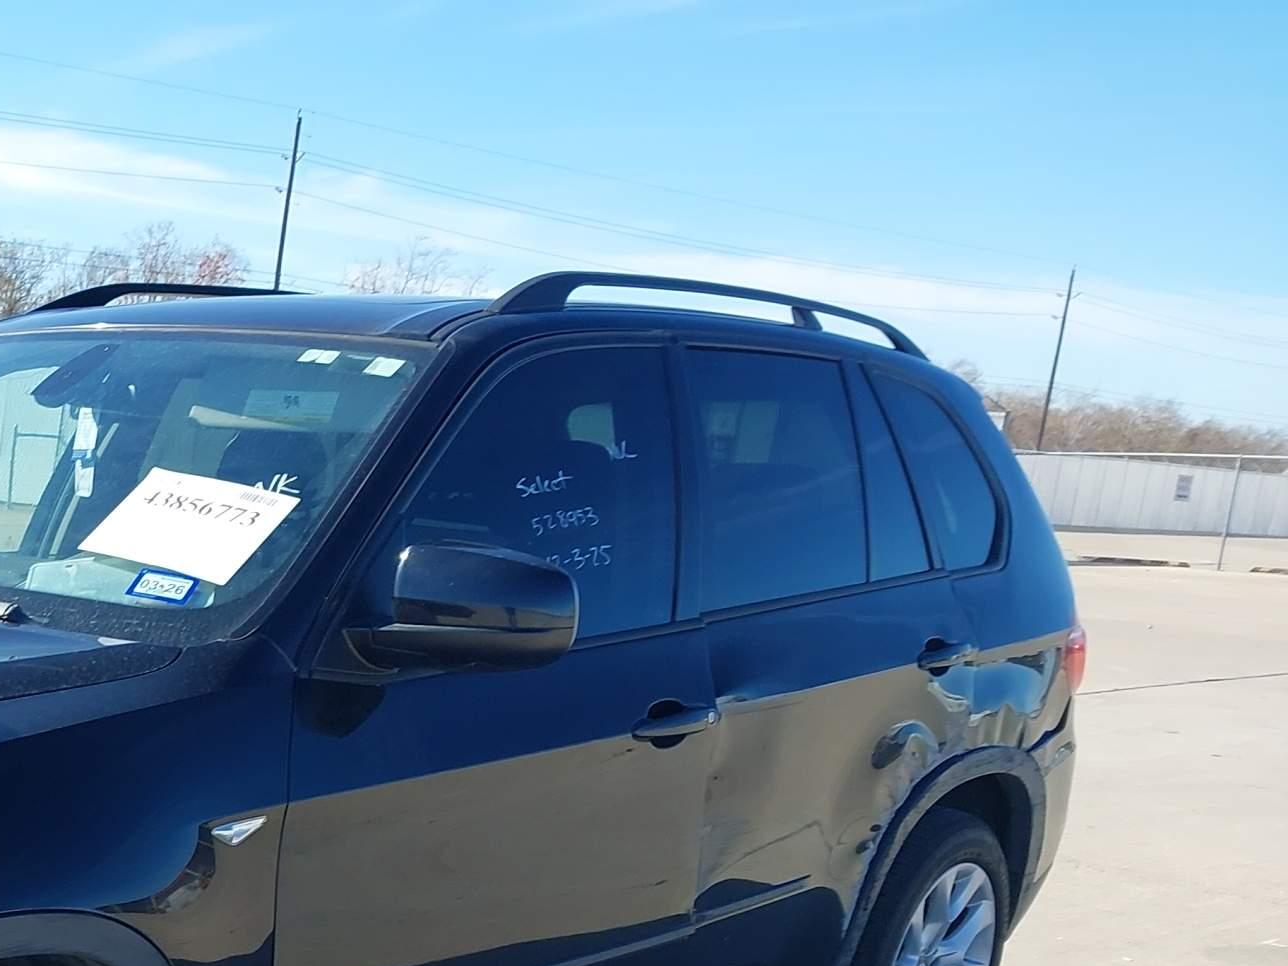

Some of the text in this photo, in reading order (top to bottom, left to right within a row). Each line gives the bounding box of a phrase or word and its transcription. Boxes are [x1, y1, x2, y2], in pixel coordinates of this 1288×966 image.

[515, 470, 574, 498] Select
[144, 490, 261, 527] 43856773
[530, 506, 600, 537] 528953
